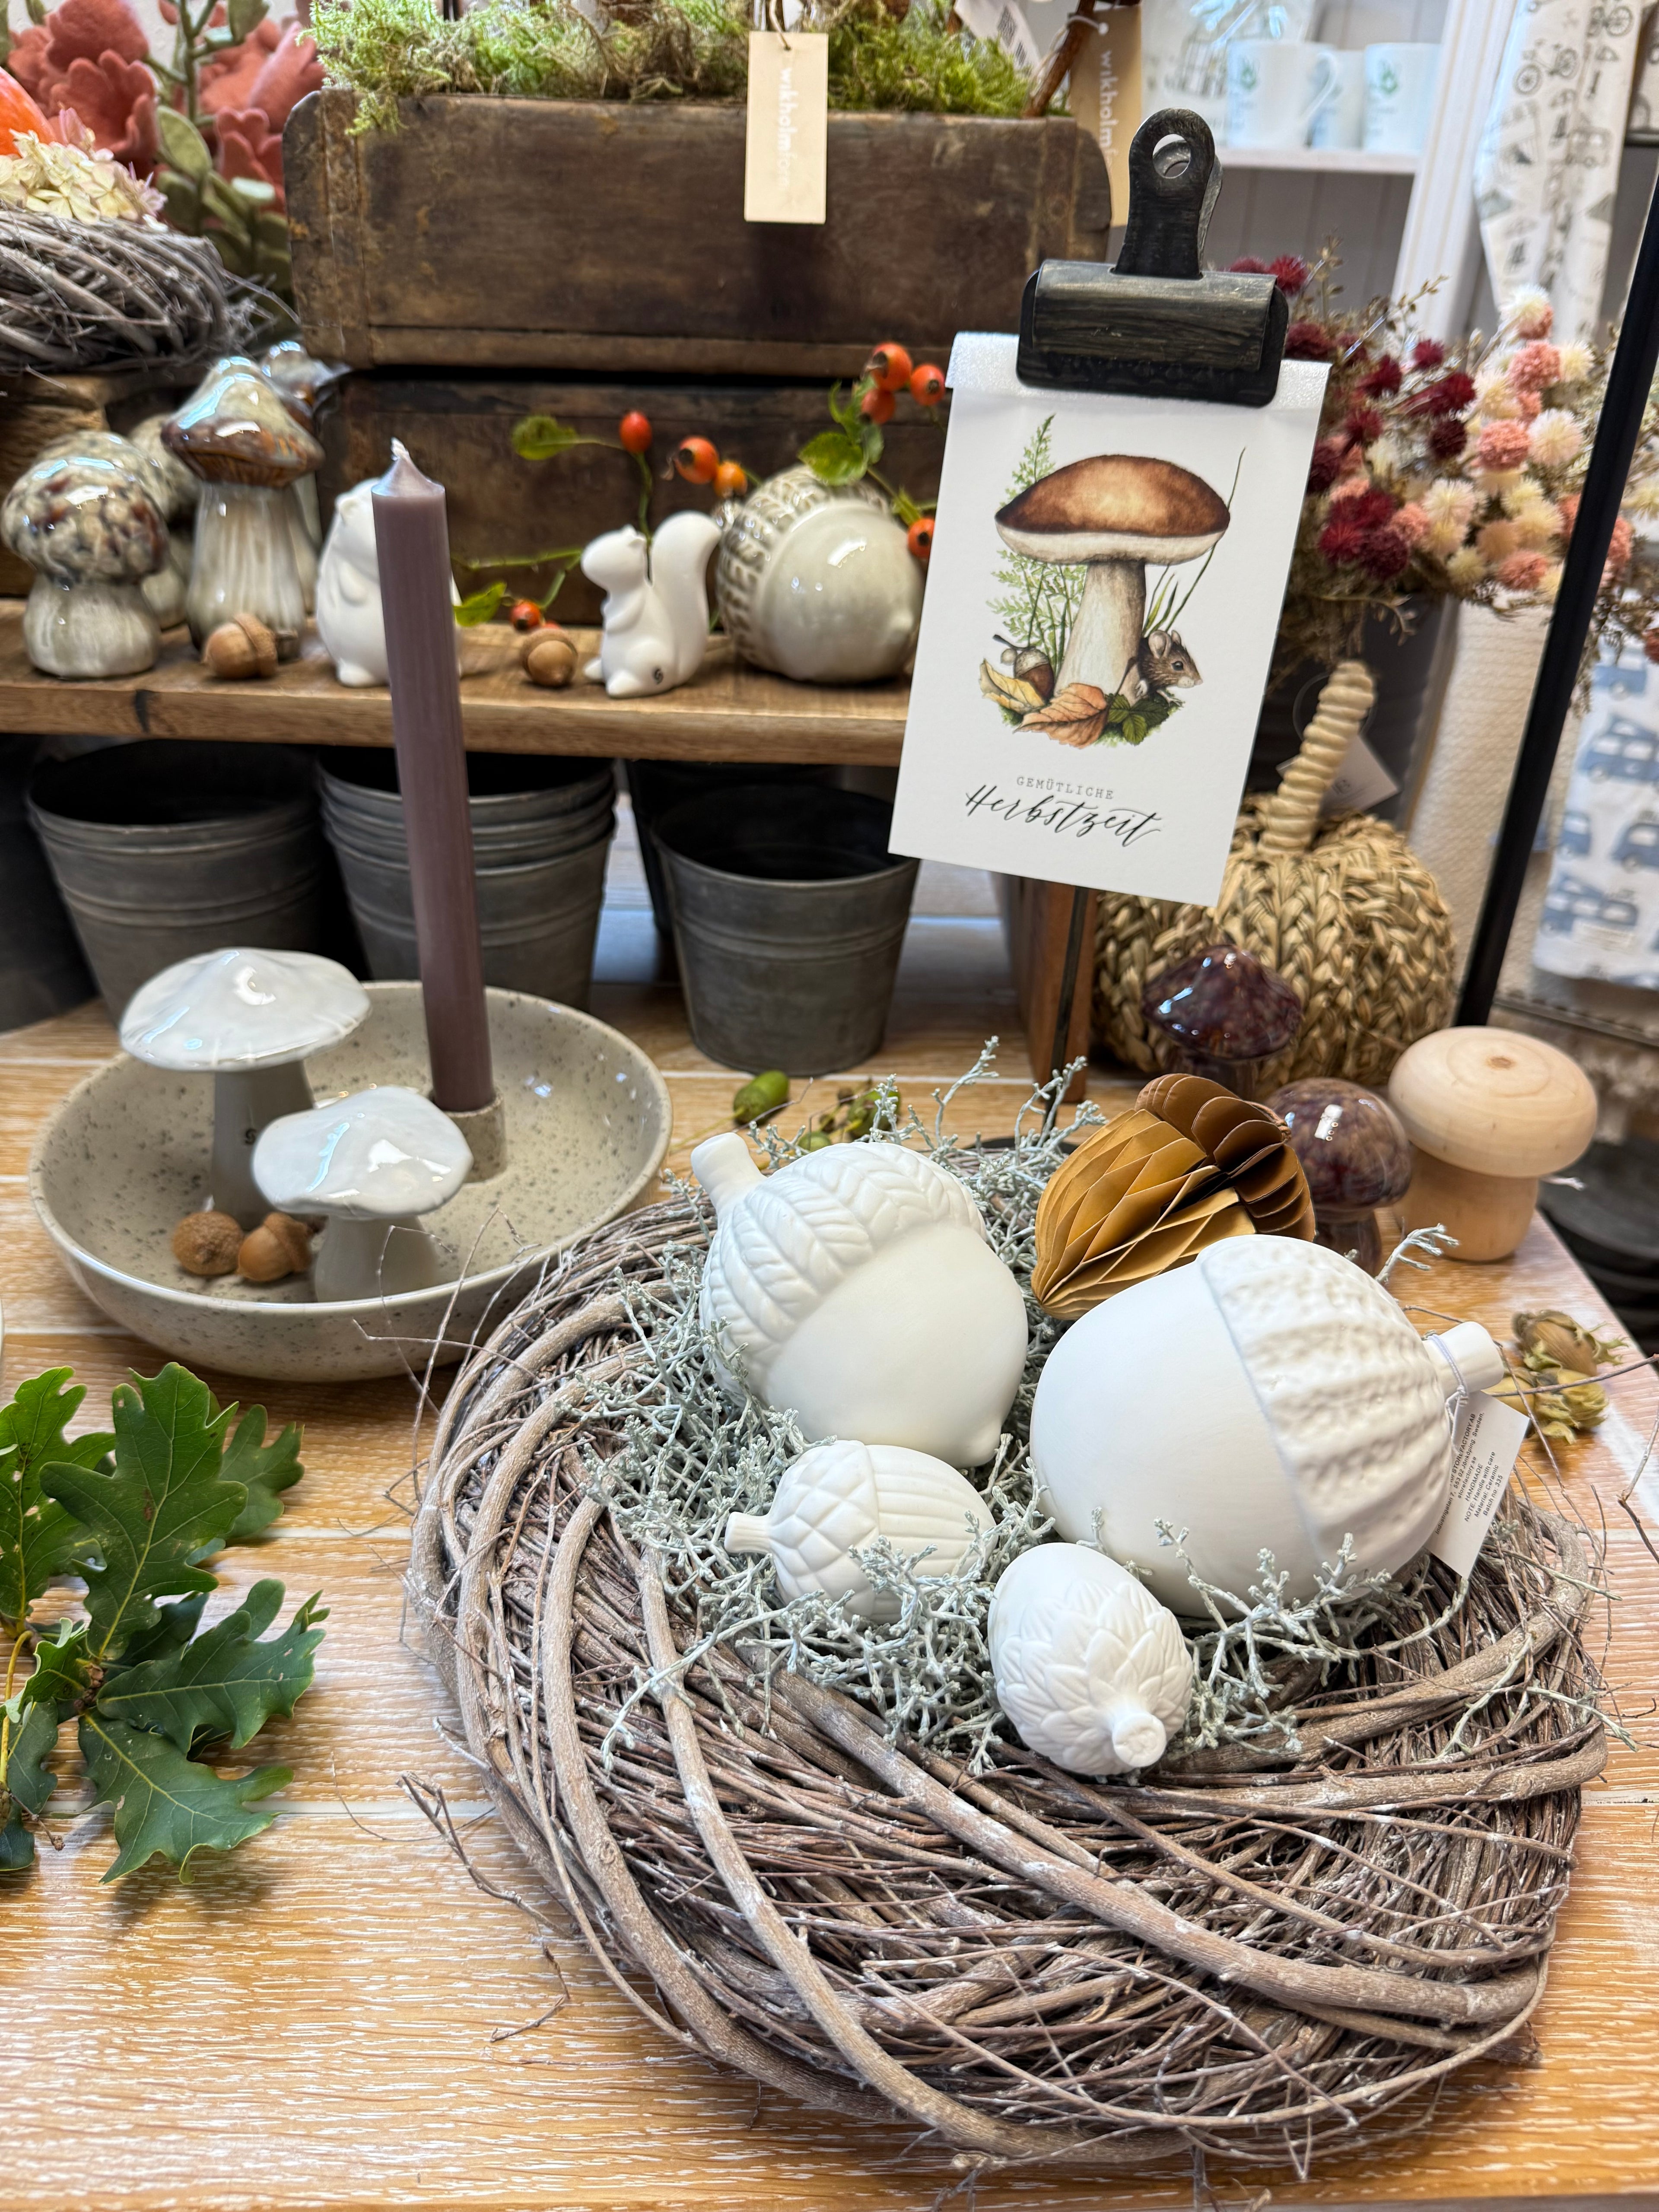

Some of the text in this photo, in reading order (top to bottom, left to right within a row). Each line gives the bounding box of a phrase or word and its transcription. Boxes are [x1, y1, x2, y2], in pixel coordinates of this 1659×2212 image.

[1016, 776, 1114, 800] GEMÜTLICHE
[965, 785, 1162, 847] Herbstzeit
[1452, 1422, 1473, 1474] STOREFACTORY
[1469, 1413, 1475, 1423] AB
[1465, 1463, 1483, 1501] HANDMADE
[1465, 1503, 1476, 1522] NOTE:
[1473, 1479, 1485, 1501] Handle
[1475, 1465, 1499, 1517] Material: Ceramic
[1435, 1497, 1454, 1535] Industrigatan
[1483, 1498, 1494, 1516] Batch
